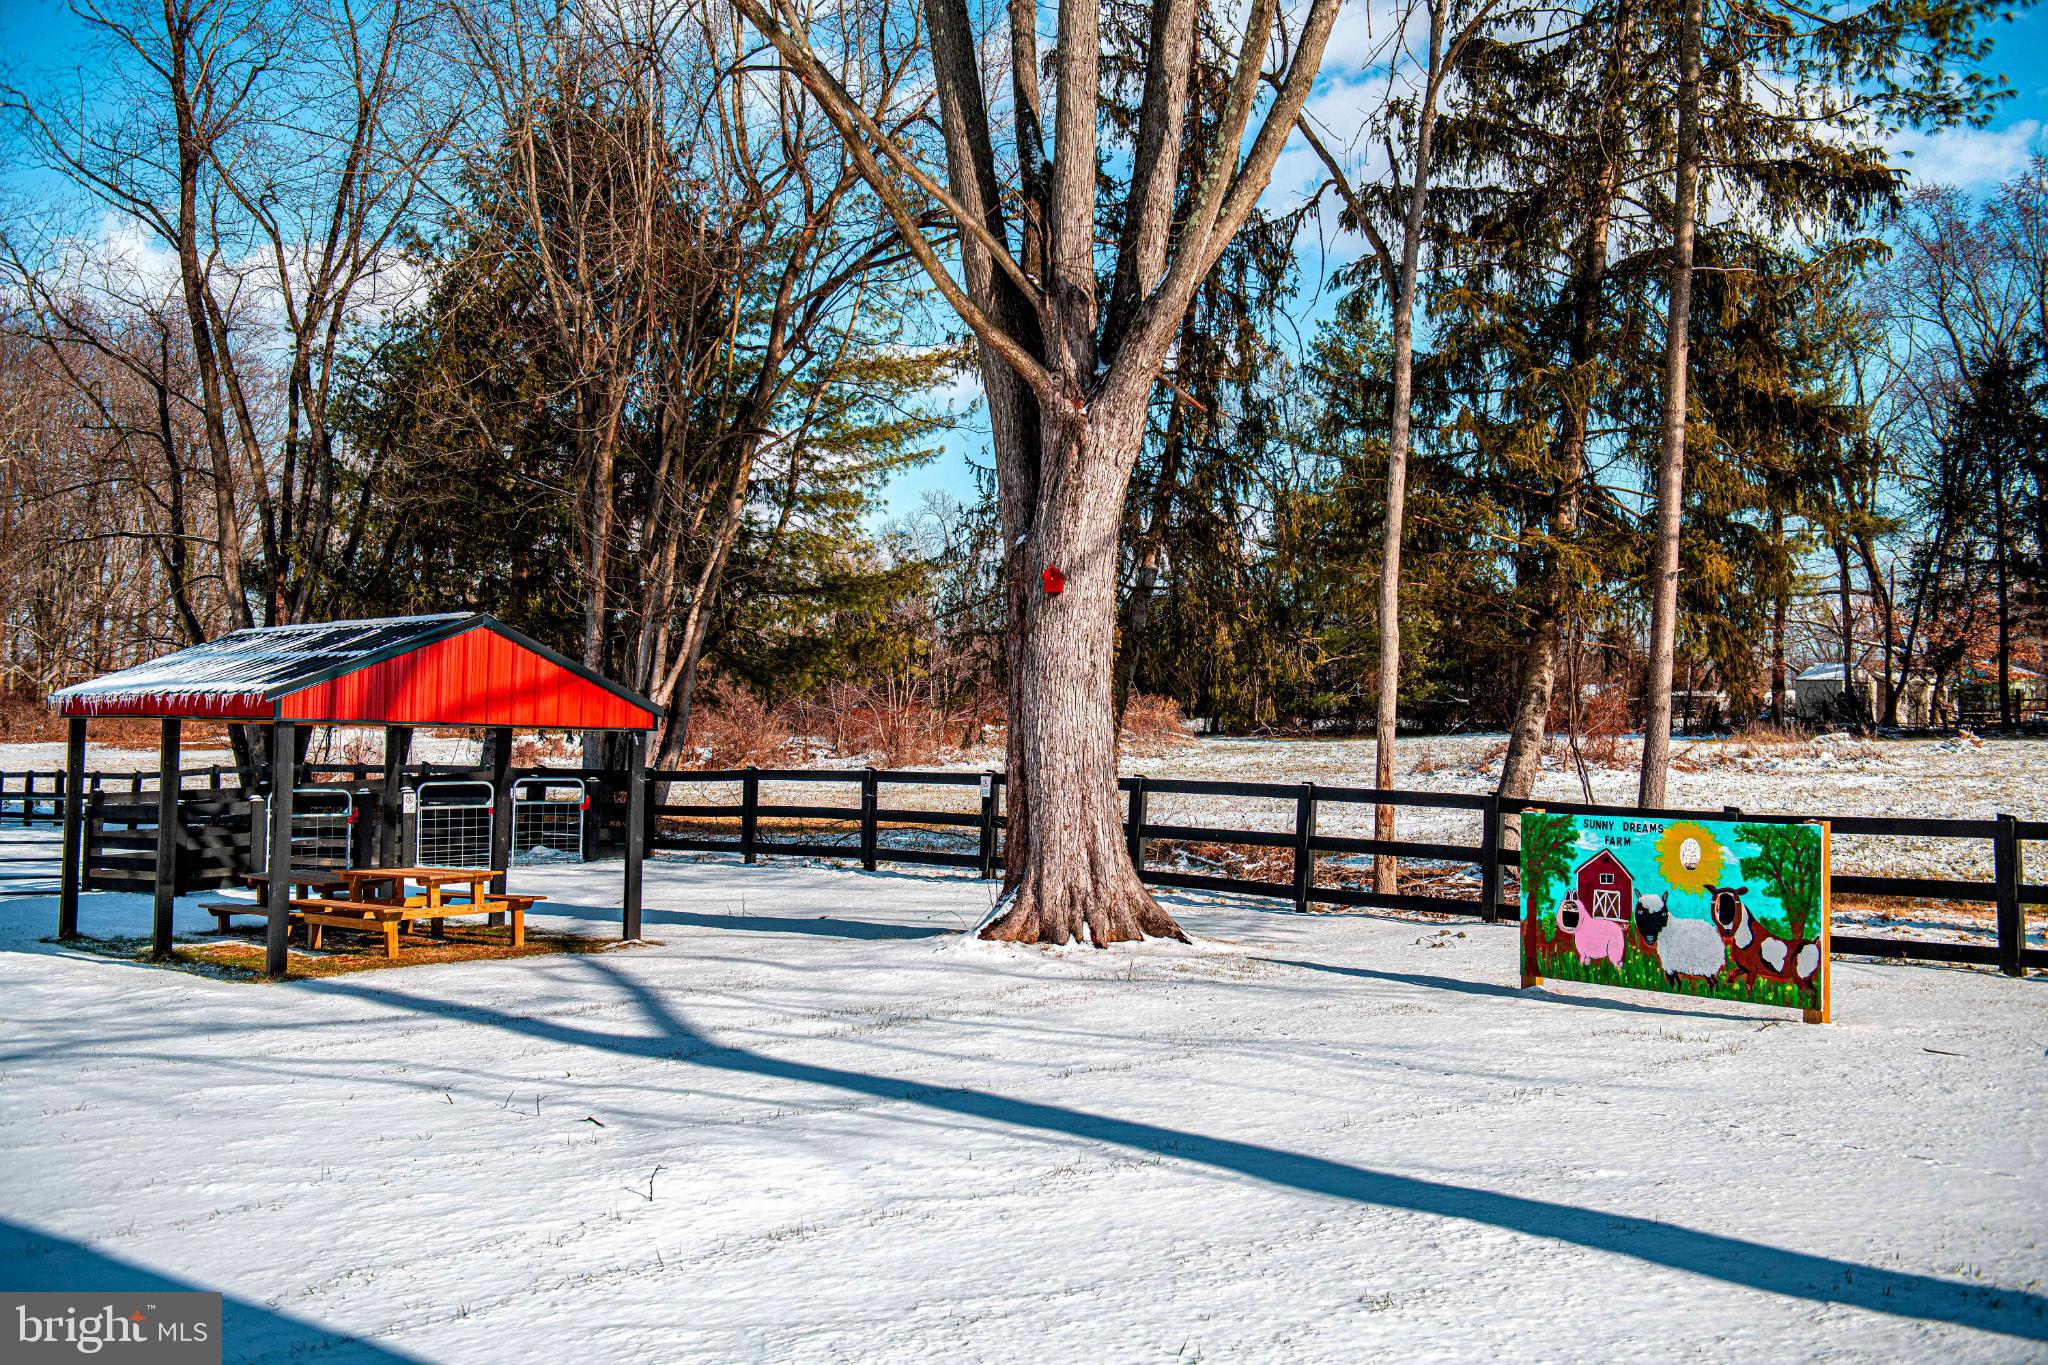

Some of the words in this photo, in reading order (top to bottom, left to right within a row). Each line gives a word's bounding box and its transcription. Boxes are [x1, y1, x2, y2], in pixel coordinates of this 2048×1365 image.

[1583, 819, 1614, 831] SUNNY
[1623, 822, 1664, 834] DREAMS
[1605, 835, 1631, 846] FARM
